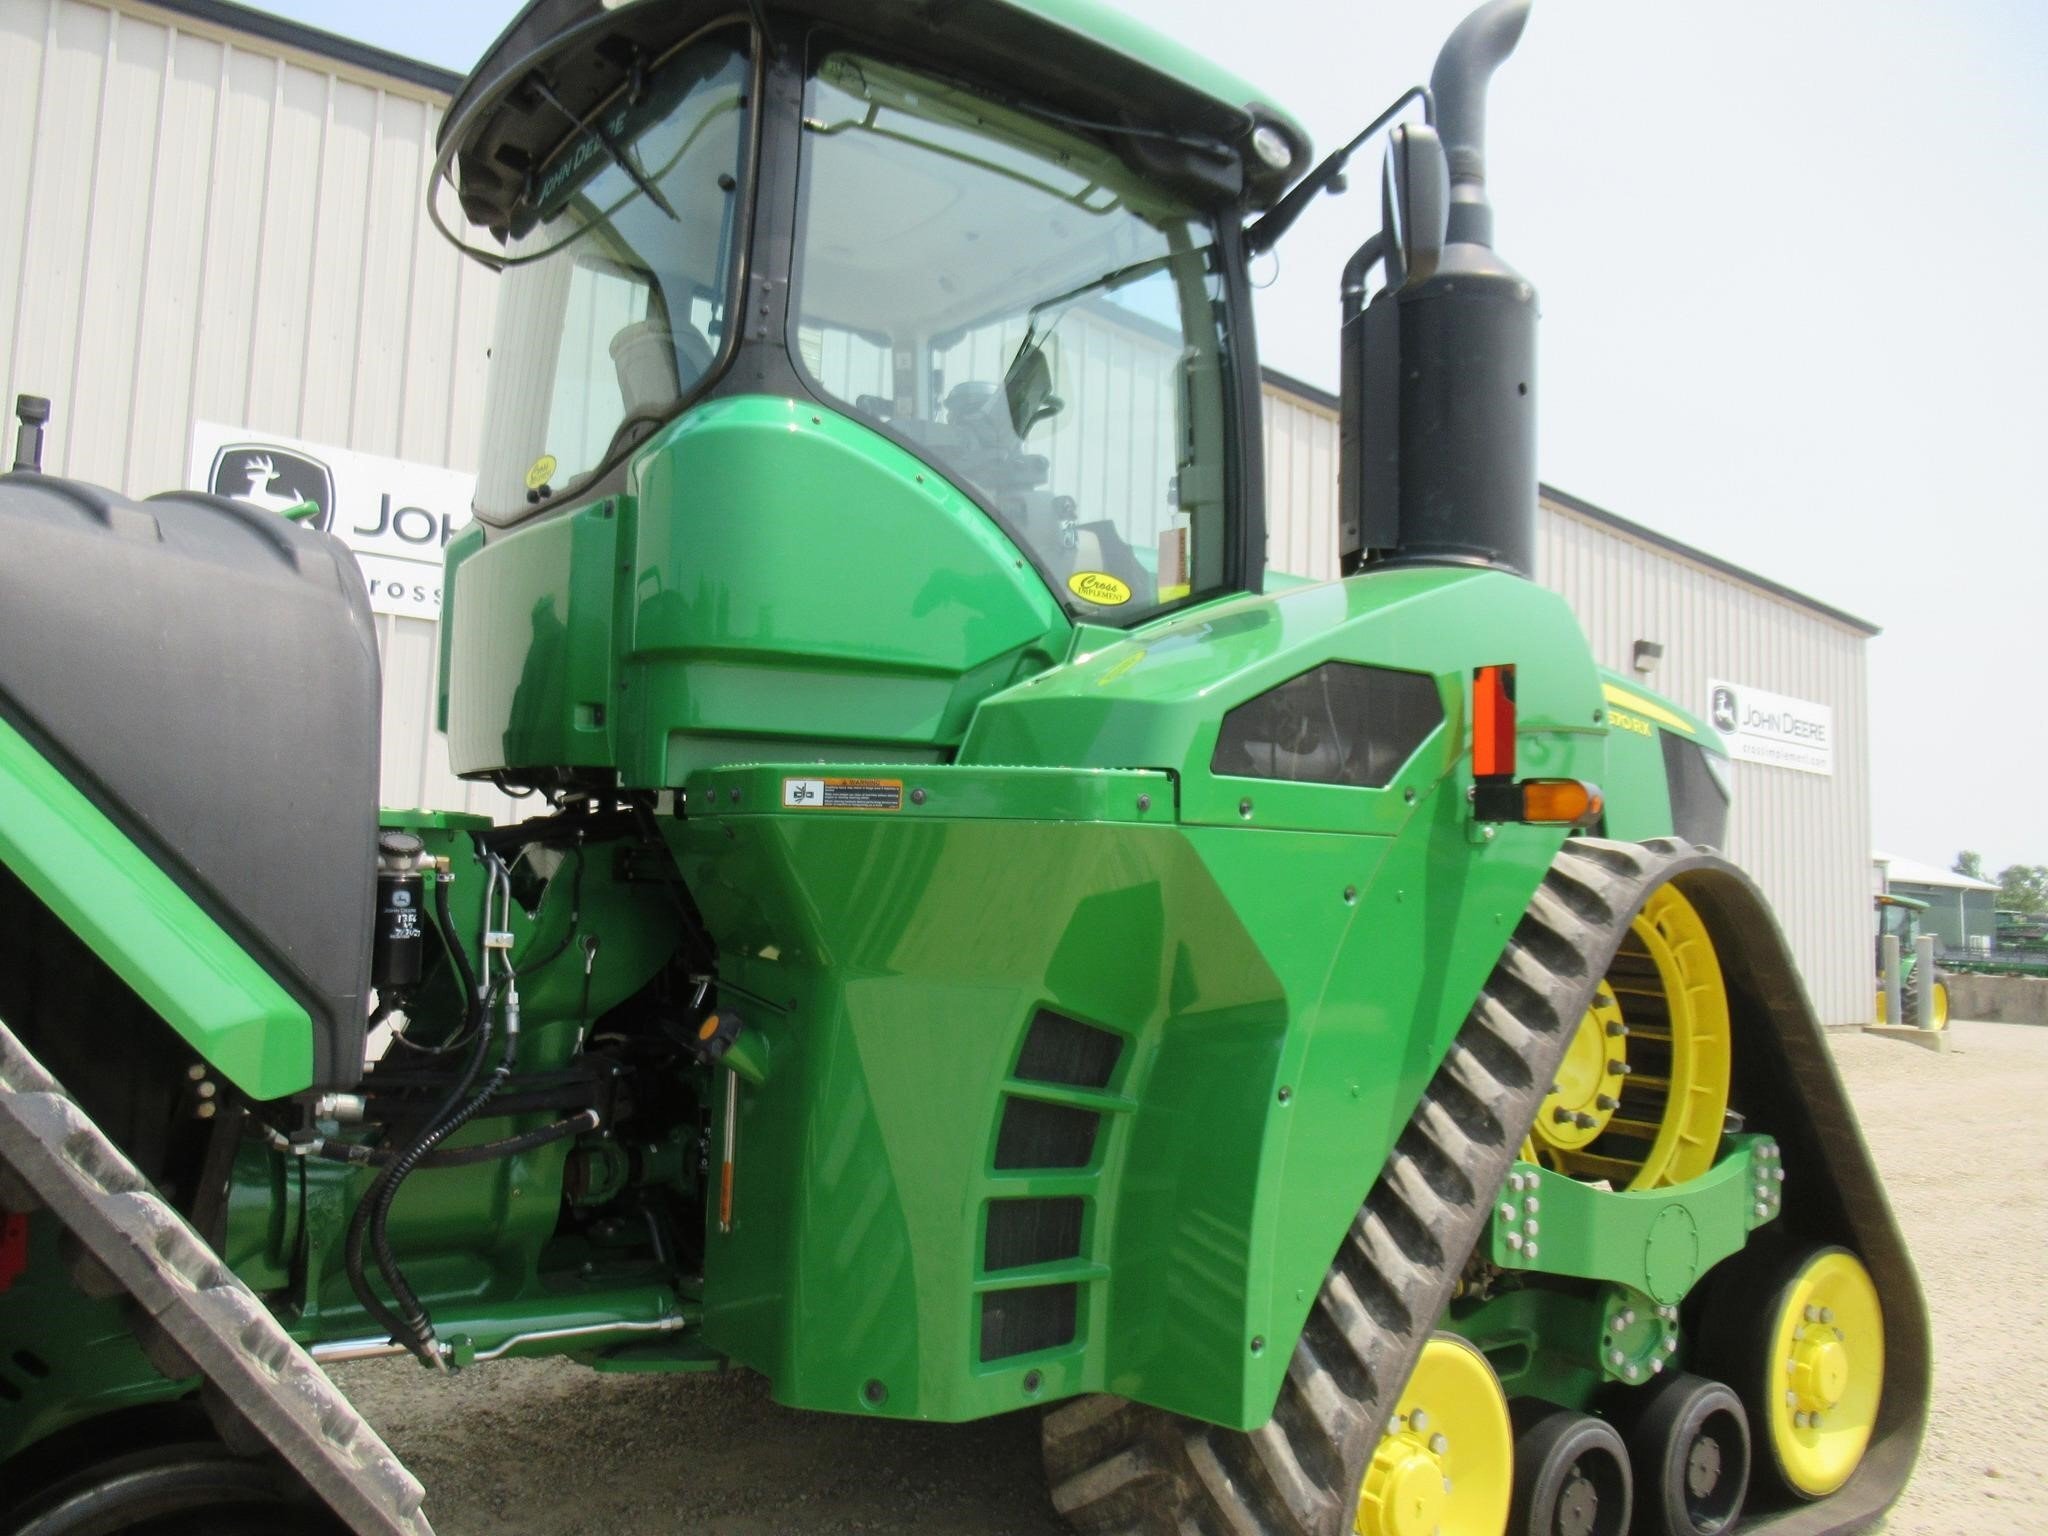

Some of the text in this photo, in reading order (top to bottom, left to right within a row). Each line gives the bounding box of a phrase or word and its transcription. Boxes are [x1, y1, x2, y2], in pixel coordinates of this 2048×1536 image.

[1081, 575, 1117, 592] Cross
[1079, 587, 1122, 600] IMPLEMENT
[1743, 703, 1826, 742] JOHN DEERE
